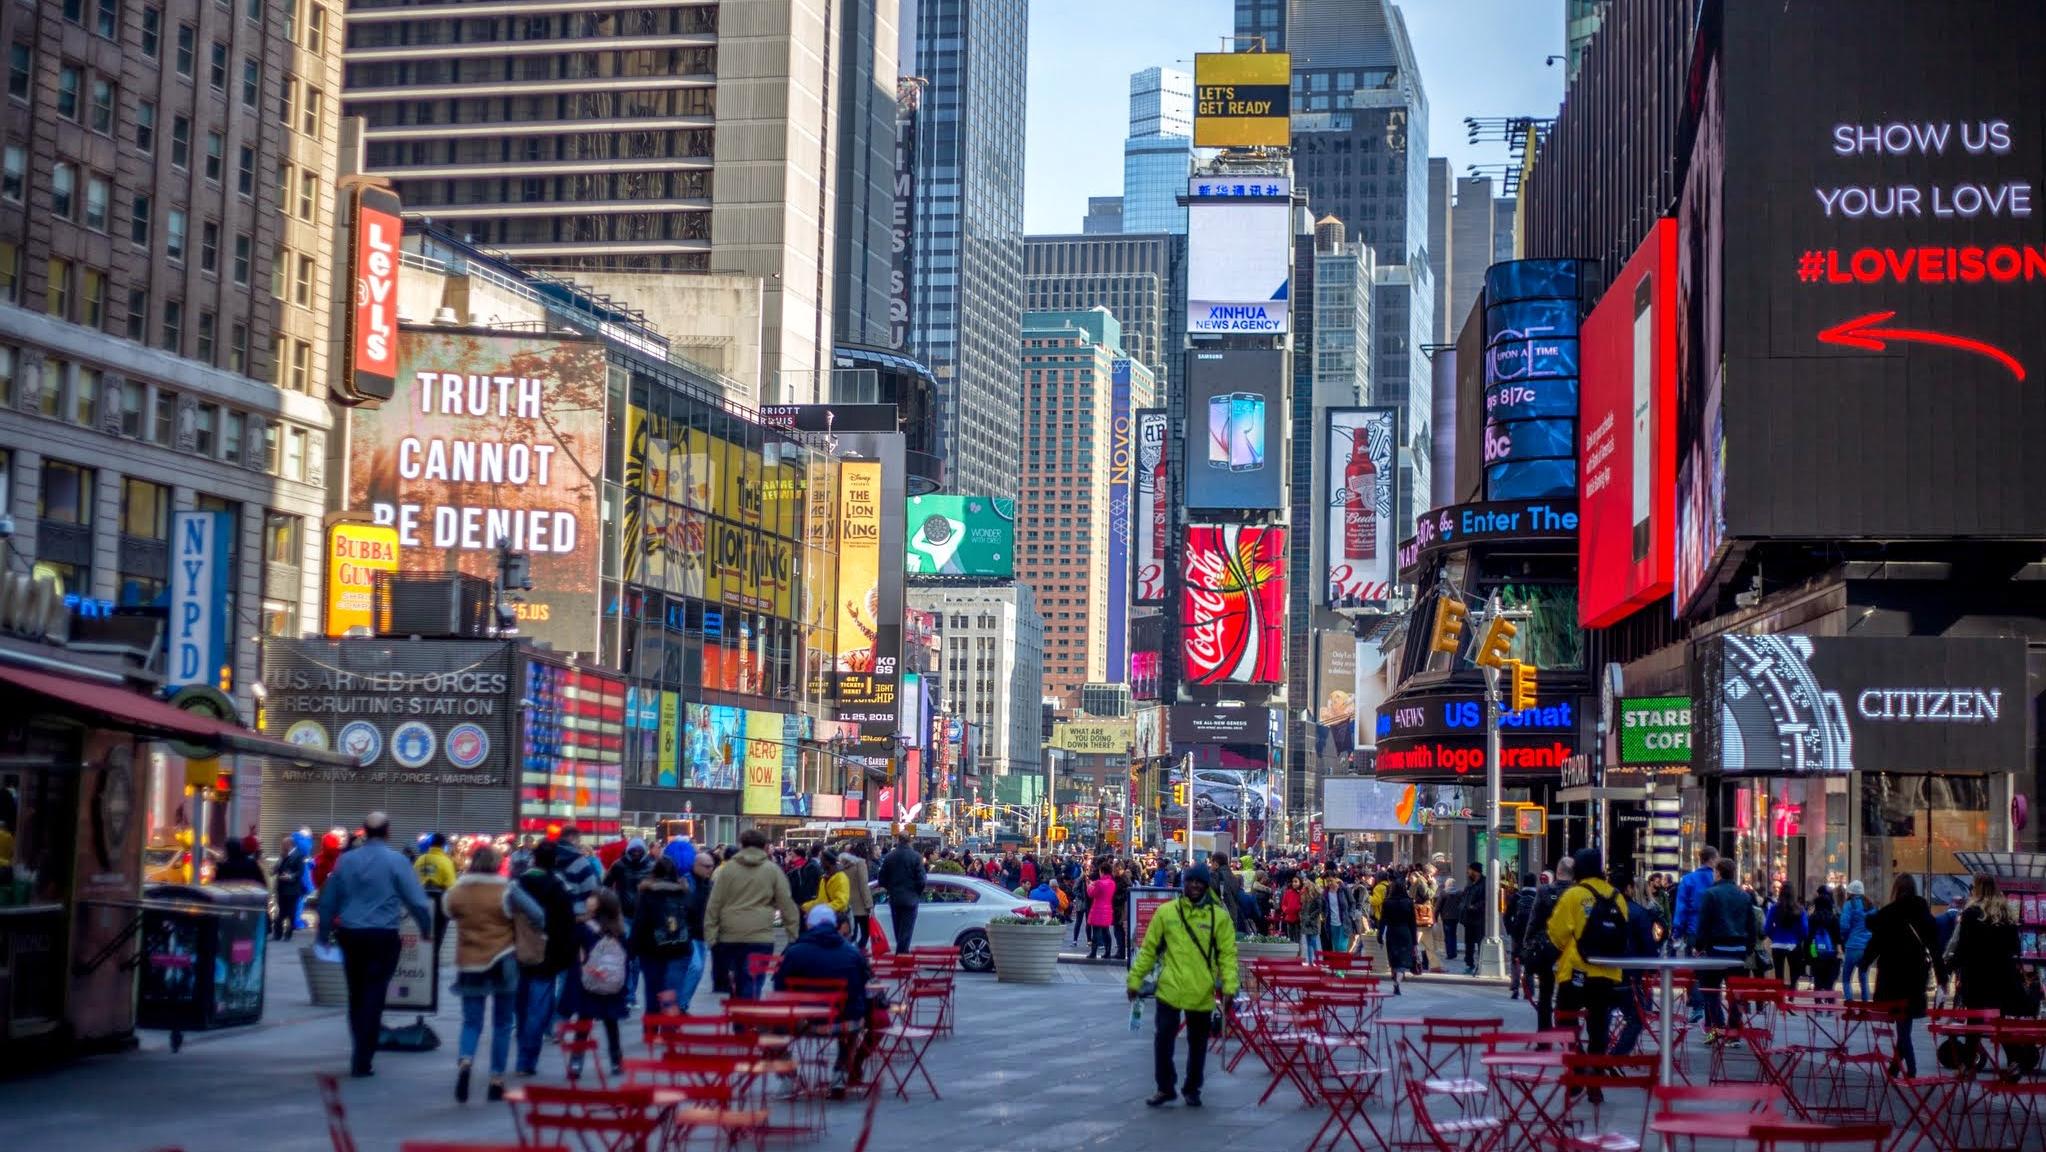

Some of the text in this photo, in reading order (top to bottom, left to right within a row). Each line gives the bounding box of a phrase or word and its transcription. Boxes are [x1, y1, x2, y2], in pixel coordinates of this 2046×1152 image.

[1199, 87, 1234, 99] LET'S
[1199, 102, 1271, 114] GET READY
[1834, 121, 2012, 155] SHOW US
[1816, 184, 2033, 217] YOUR LOVE
[1798, 246, 2046, 284] #LOVEISON
[1210, 306, 1267, 319] XINHUA
[1196, 320, 1280, 330] NEWS AGENCY
[1535, 346, 1559, 356] TIME
[416, 371, 542, 419] TRUTH
[399, 436, 556, 486] CANNOT
[849, 490, 869, 500] THE
[845, 502, 874, 518] LION
[1462, 510, 1519, 534] Enter
[1528, 505, 1578, 530] The
[373, 501, 577, 553] BE DENIED
[843, 519, 877, 539] KING
[970, 528, 1002, 538] WONDER
[336, 535, 393, 560] BUBBA
[182, 518, 206, 680] NYPD
[320, 670, 405, 691] ARMED
[408, 672, 507, 694] FORCES
[284, 695, 493, 715] RECRUITING STATION
[1857, 688, 2002, 721] CITIZEN
[869, 713, 894, 721] 2015
[1400, 706, 1425, 729] NEWS
[1445, 701, 1480, 728] US
[1625, 709, 1692, 727] STARB
[749, 742, 777, 759] AERO
[1067, 741, 1115, 749] DOWN THERE?
[1437, 744, 1484, 774] logo
[393, 772, 432, 783] FORCE
[441, 774, 491, 785] MARINES
[749, 766, 775, 784] NOW.
